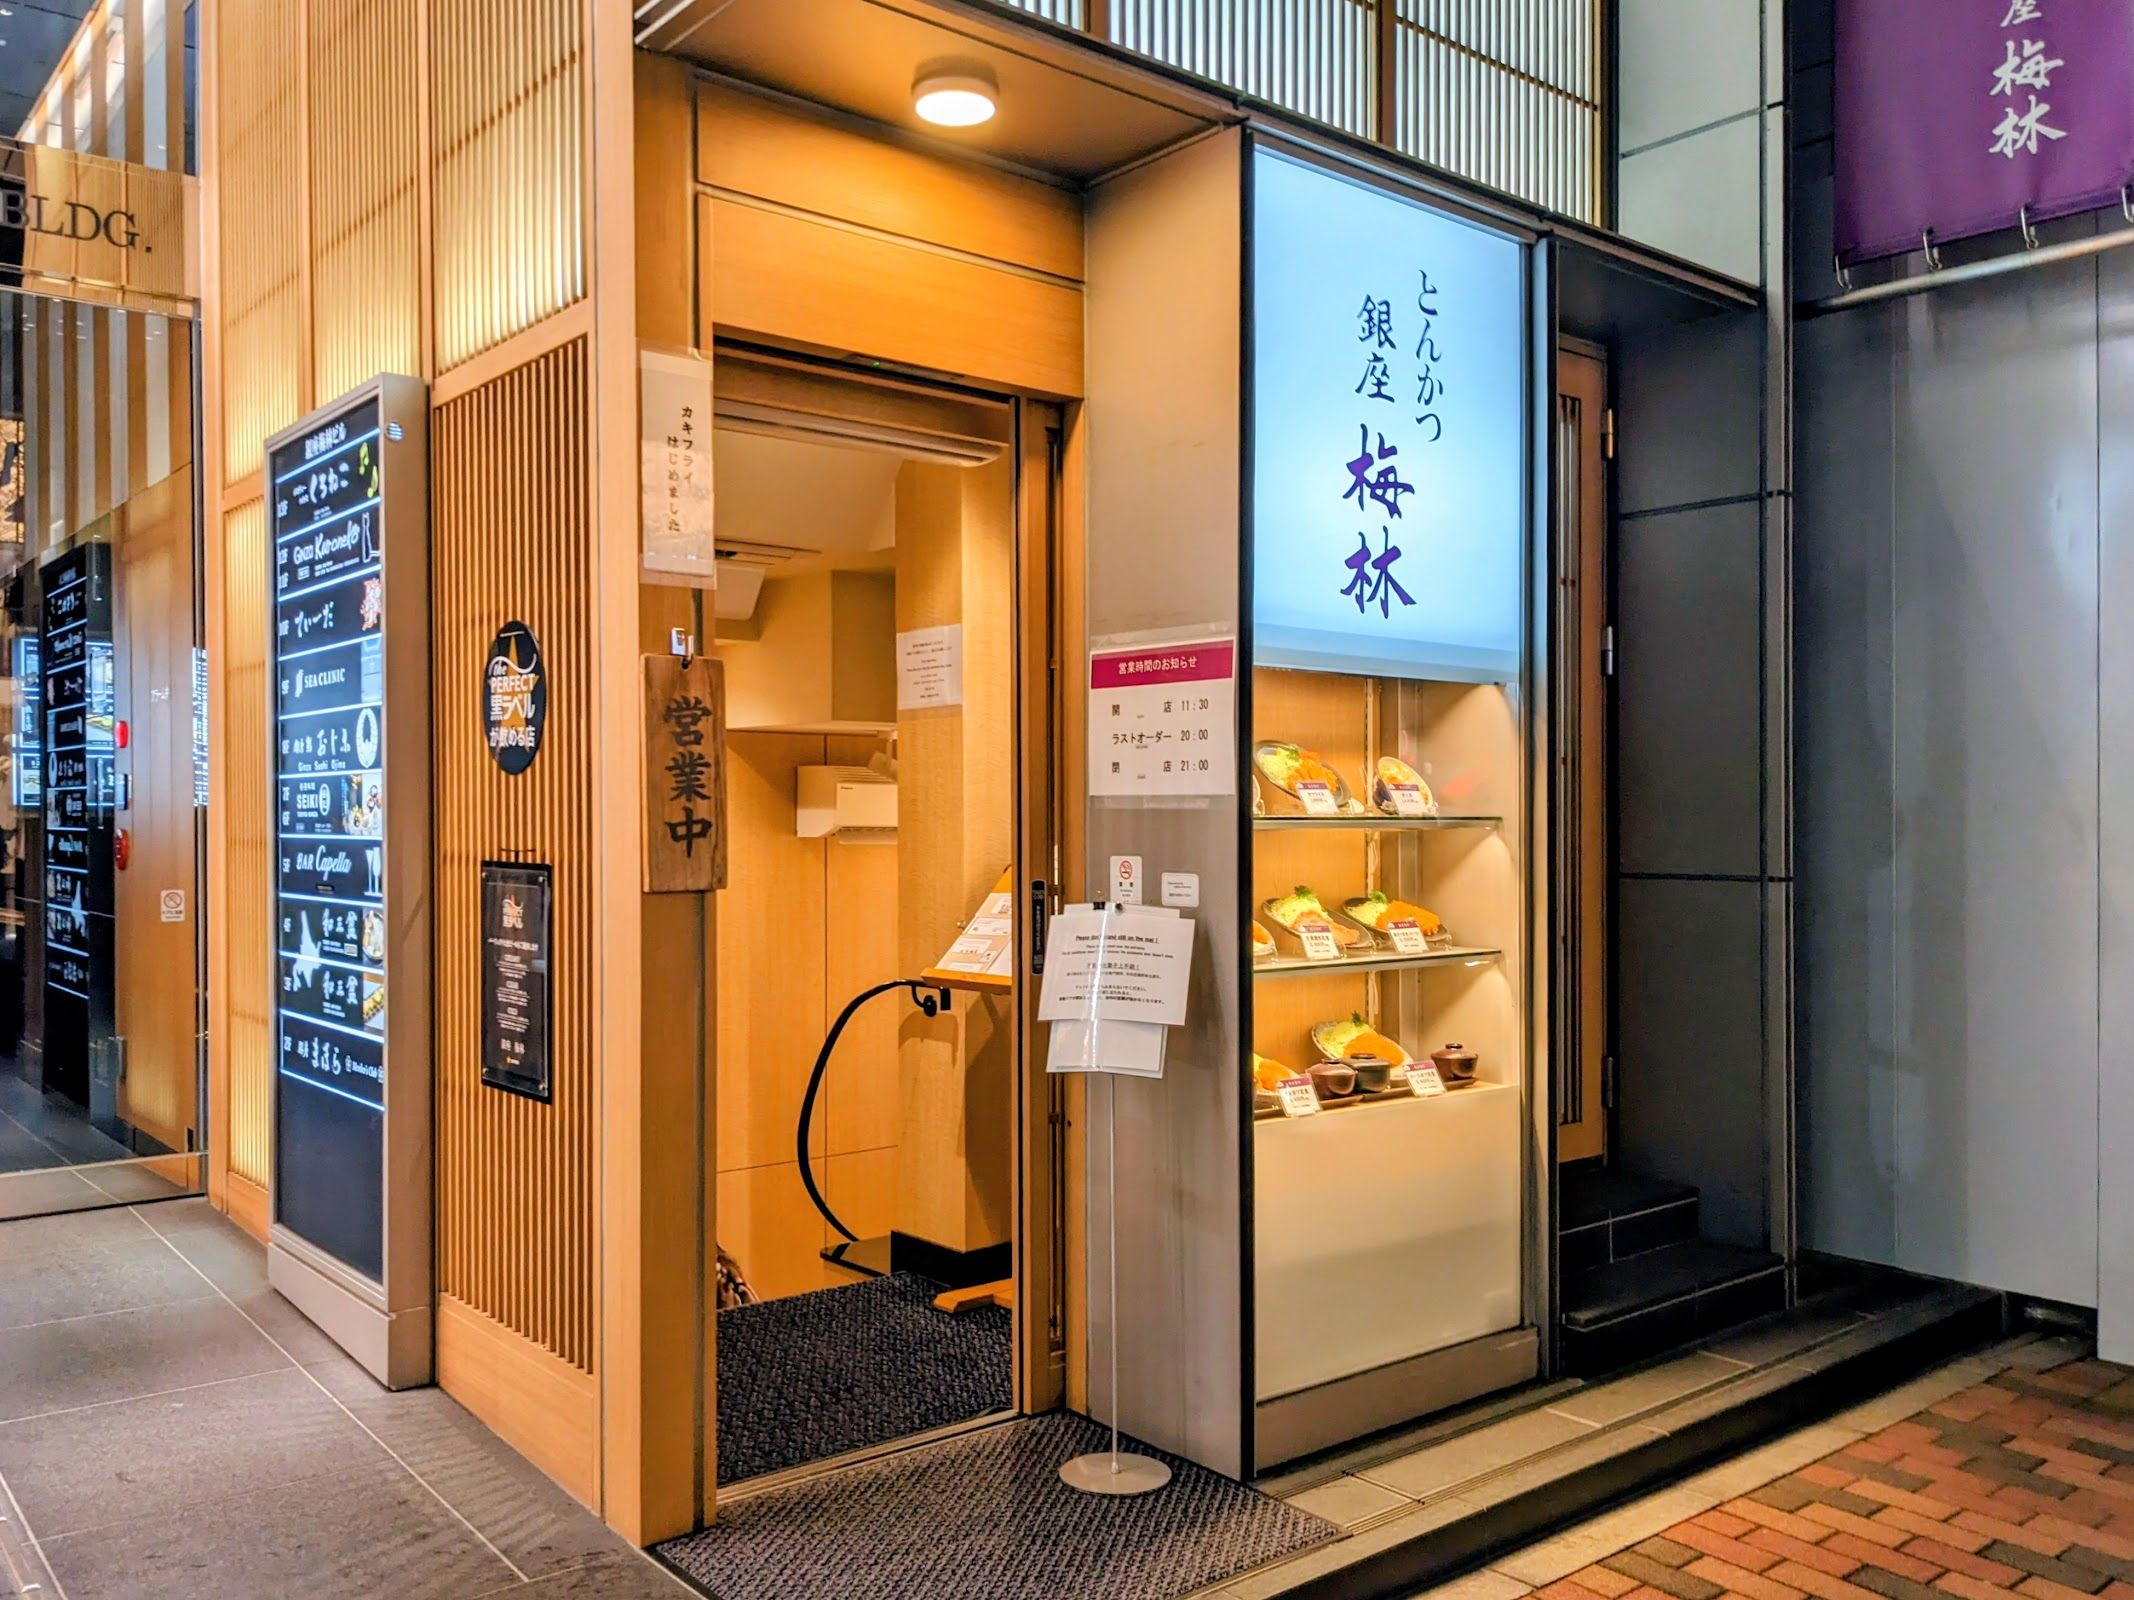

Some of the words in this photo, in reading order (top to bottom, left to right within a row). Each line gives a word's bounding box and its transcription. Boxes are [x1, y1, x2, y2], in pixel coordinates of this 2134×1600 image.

[0, 188, 152, 253] BLDG.
[1415, 269, 1444, 443] とんかつ
[681, 405, 694, 485] カキフライ
[309, 462, 350, 504] くろねこ
[666, 435, 681, 533] はじめました
[304, 674, 318, 689] SEA
[318, 667, 346, 687] CLINIC
[1118, 656, 1198, 675] 営業時間のお知らせ
[490, 673, 536, 694] PERFECT
[490, 694, 536, 722] 黒ラベル
[1181, 698, 1209, 712] 11:30
[489, 726, 536, 748] が飲める店
[1112, 730, 1172, 745] ラストオーダー
[1180, 729, 1209, 742] 20:00
[663, 695, 713, 859] 営業中
[1180, 759, 1209, 772] 21:00
[296, 793, 319, 810] SEIKI
[296, 852, 314, 871] BAR
[315, 844, 353, 882] Capella
